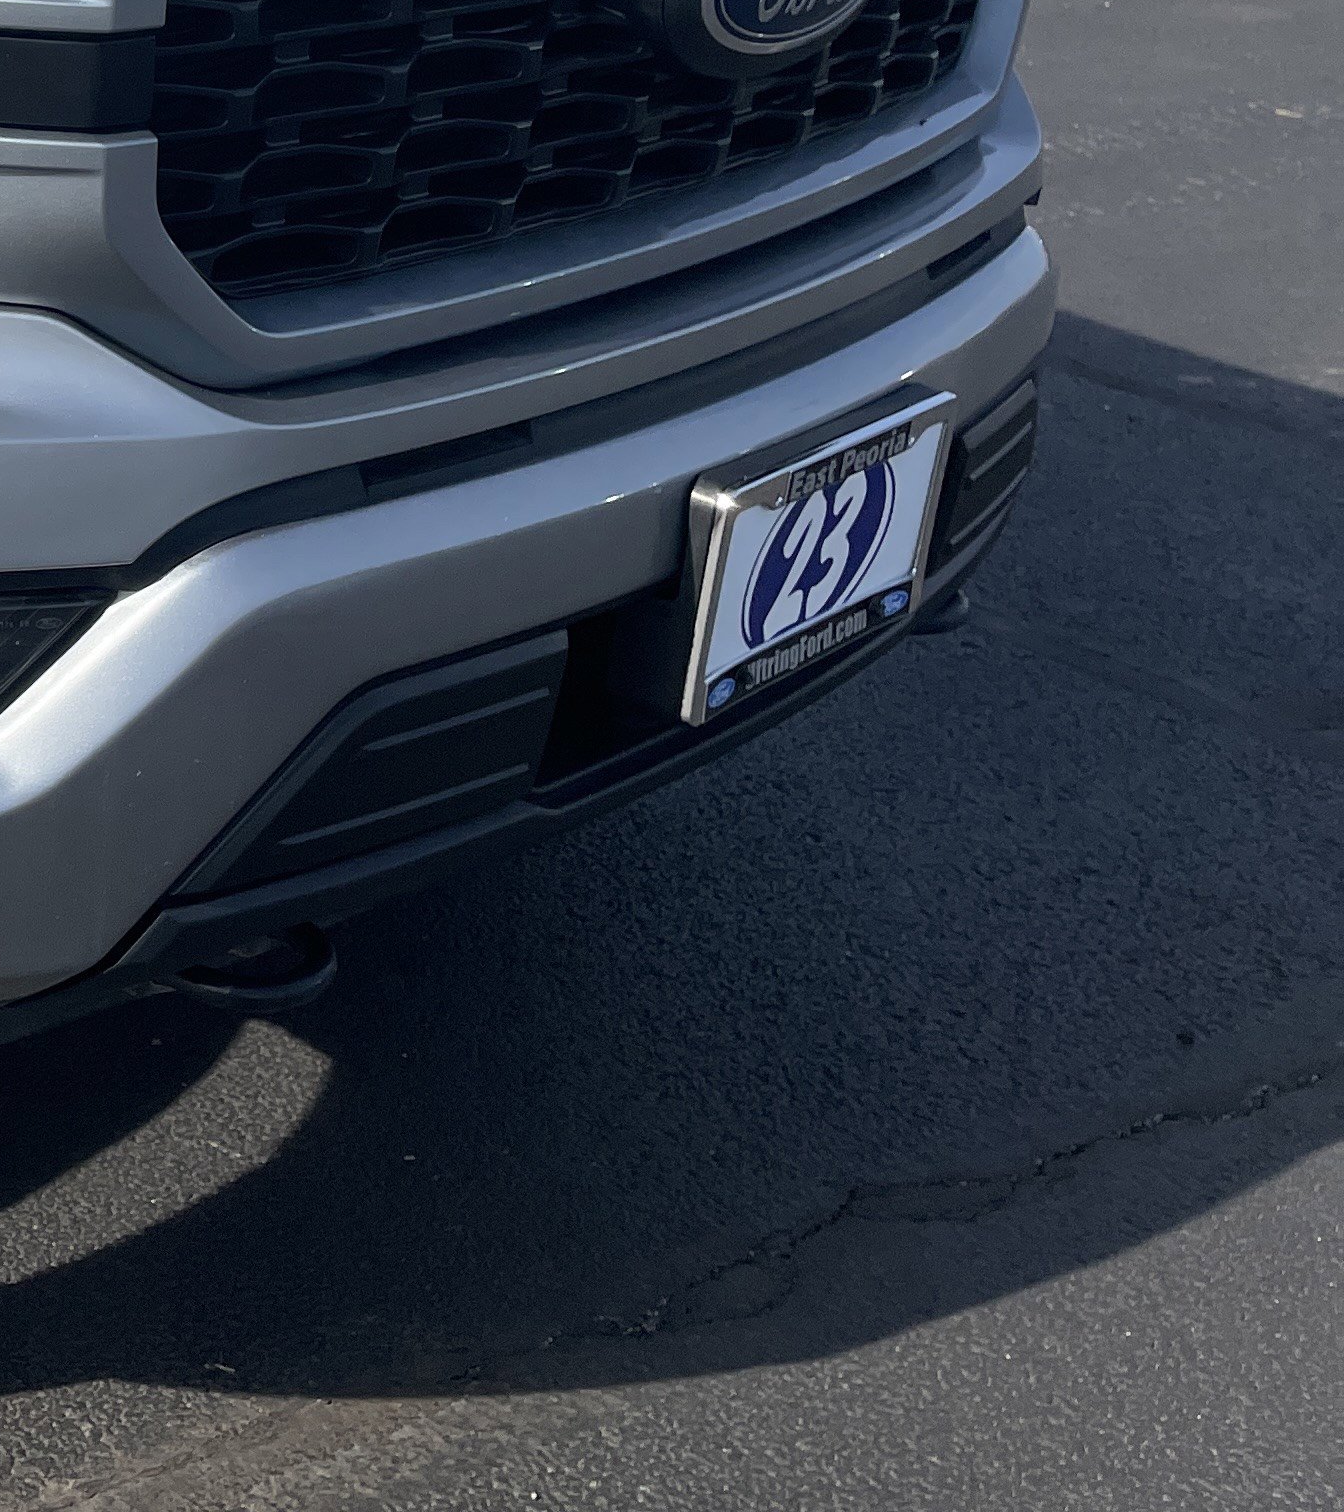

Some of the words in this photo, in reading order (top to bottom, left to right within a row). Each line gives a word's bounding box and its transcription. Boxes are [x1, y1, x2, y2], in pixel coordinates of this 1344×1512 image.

[789, 456, 837, 501] East
[840, 427, 908, 480] Peoria
[763, 469, 868, 640] 23
